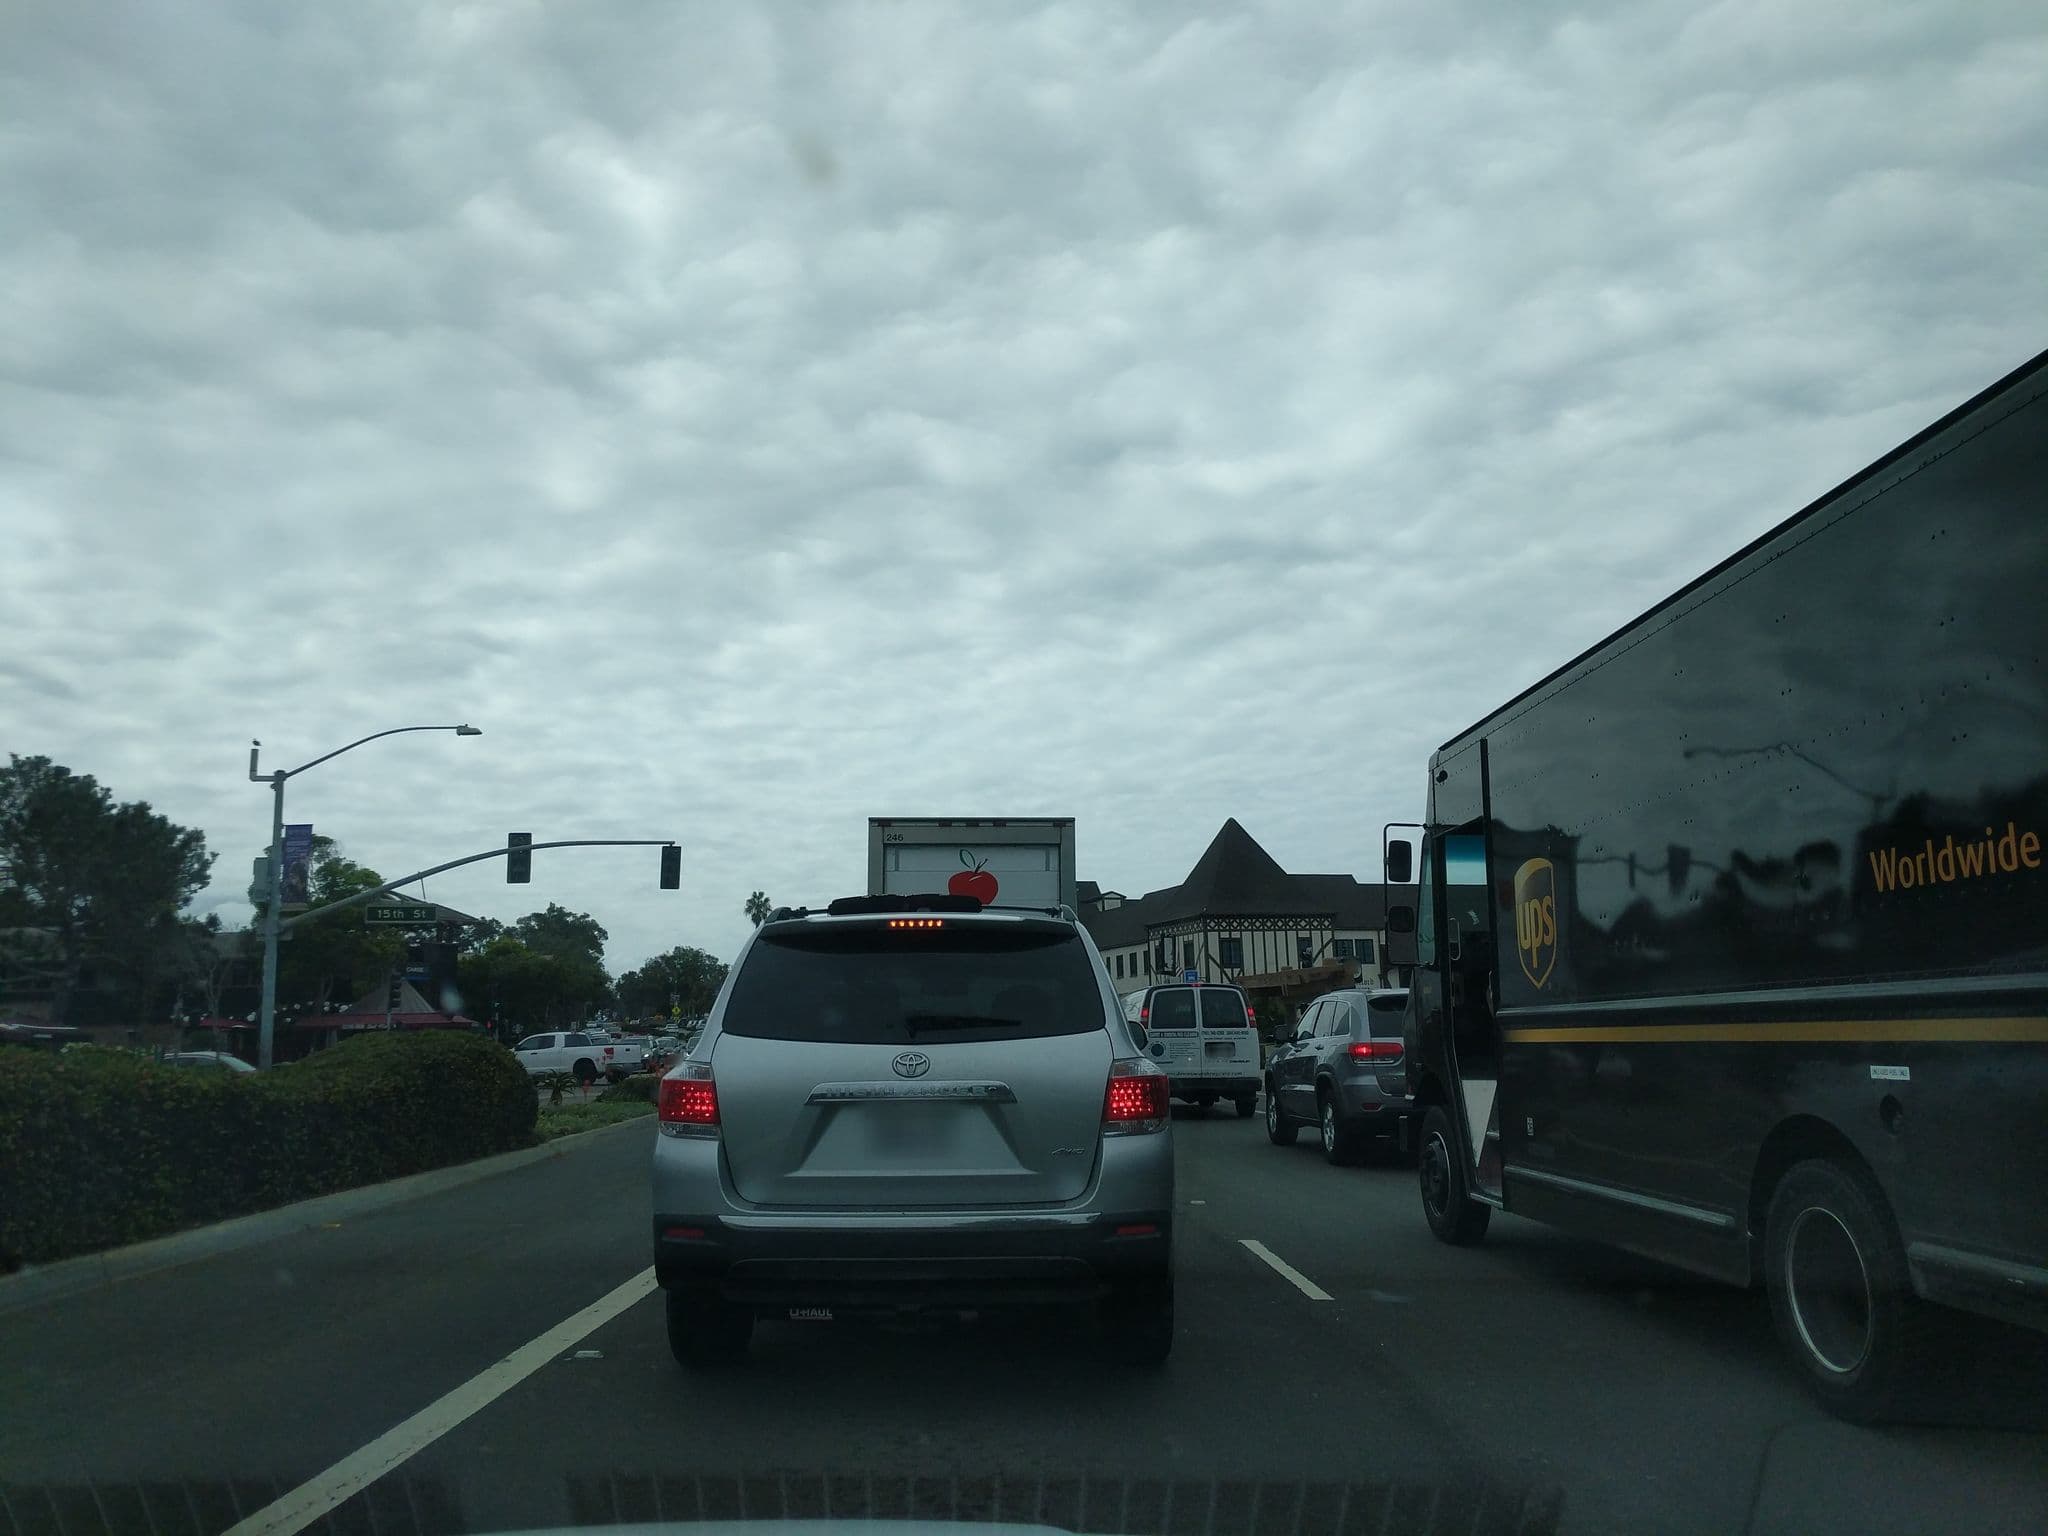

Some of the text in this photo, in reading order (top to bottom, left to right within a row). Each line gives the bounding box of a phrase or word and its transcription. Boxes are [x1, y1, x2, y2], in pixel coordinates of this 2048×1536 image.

[886, 833, 904, 842] 246
[1869, 821, 2041, 893] Worldwide
[378, 909, 426, 919] 15th St
[1519, 896, 1553, 969] ups
